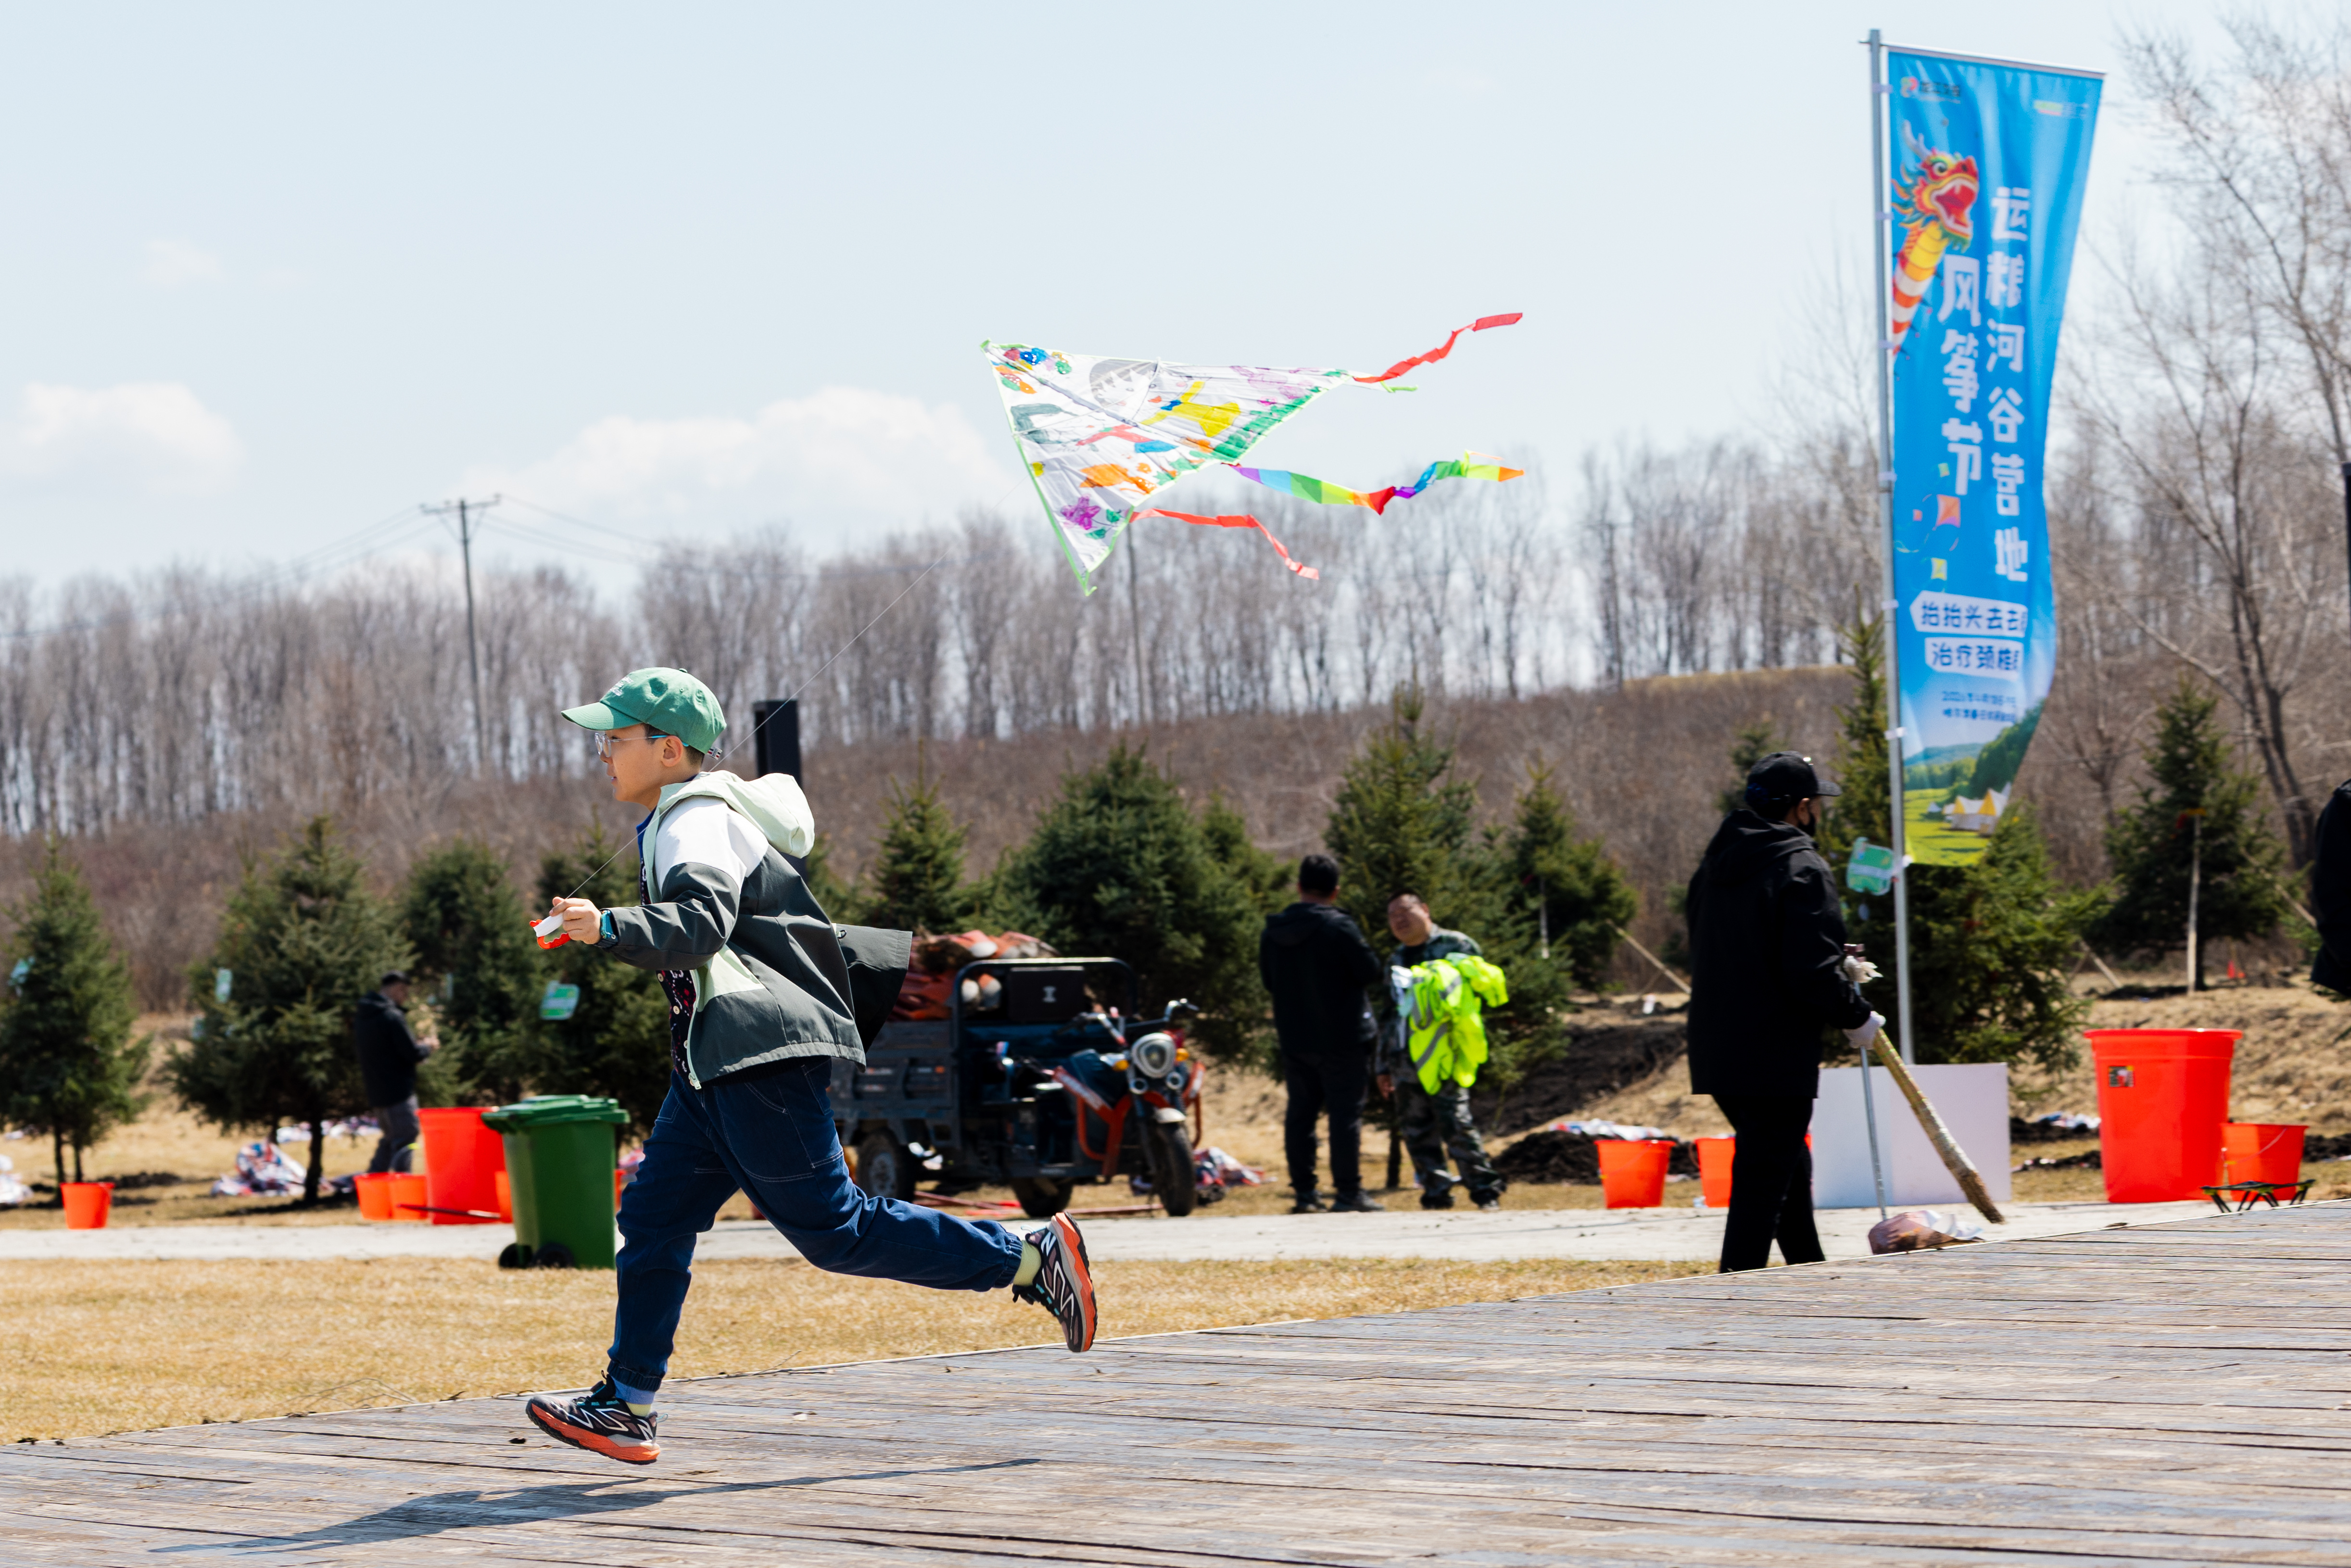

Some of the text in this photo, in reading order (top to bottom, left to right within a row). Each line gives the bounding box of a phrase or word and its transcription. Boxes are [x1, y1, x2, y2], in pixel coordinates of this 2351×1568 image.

[1937, 254, 1983, 496] 风筝节
[1984, 186, 2031, 582] 运粮河谷营地
